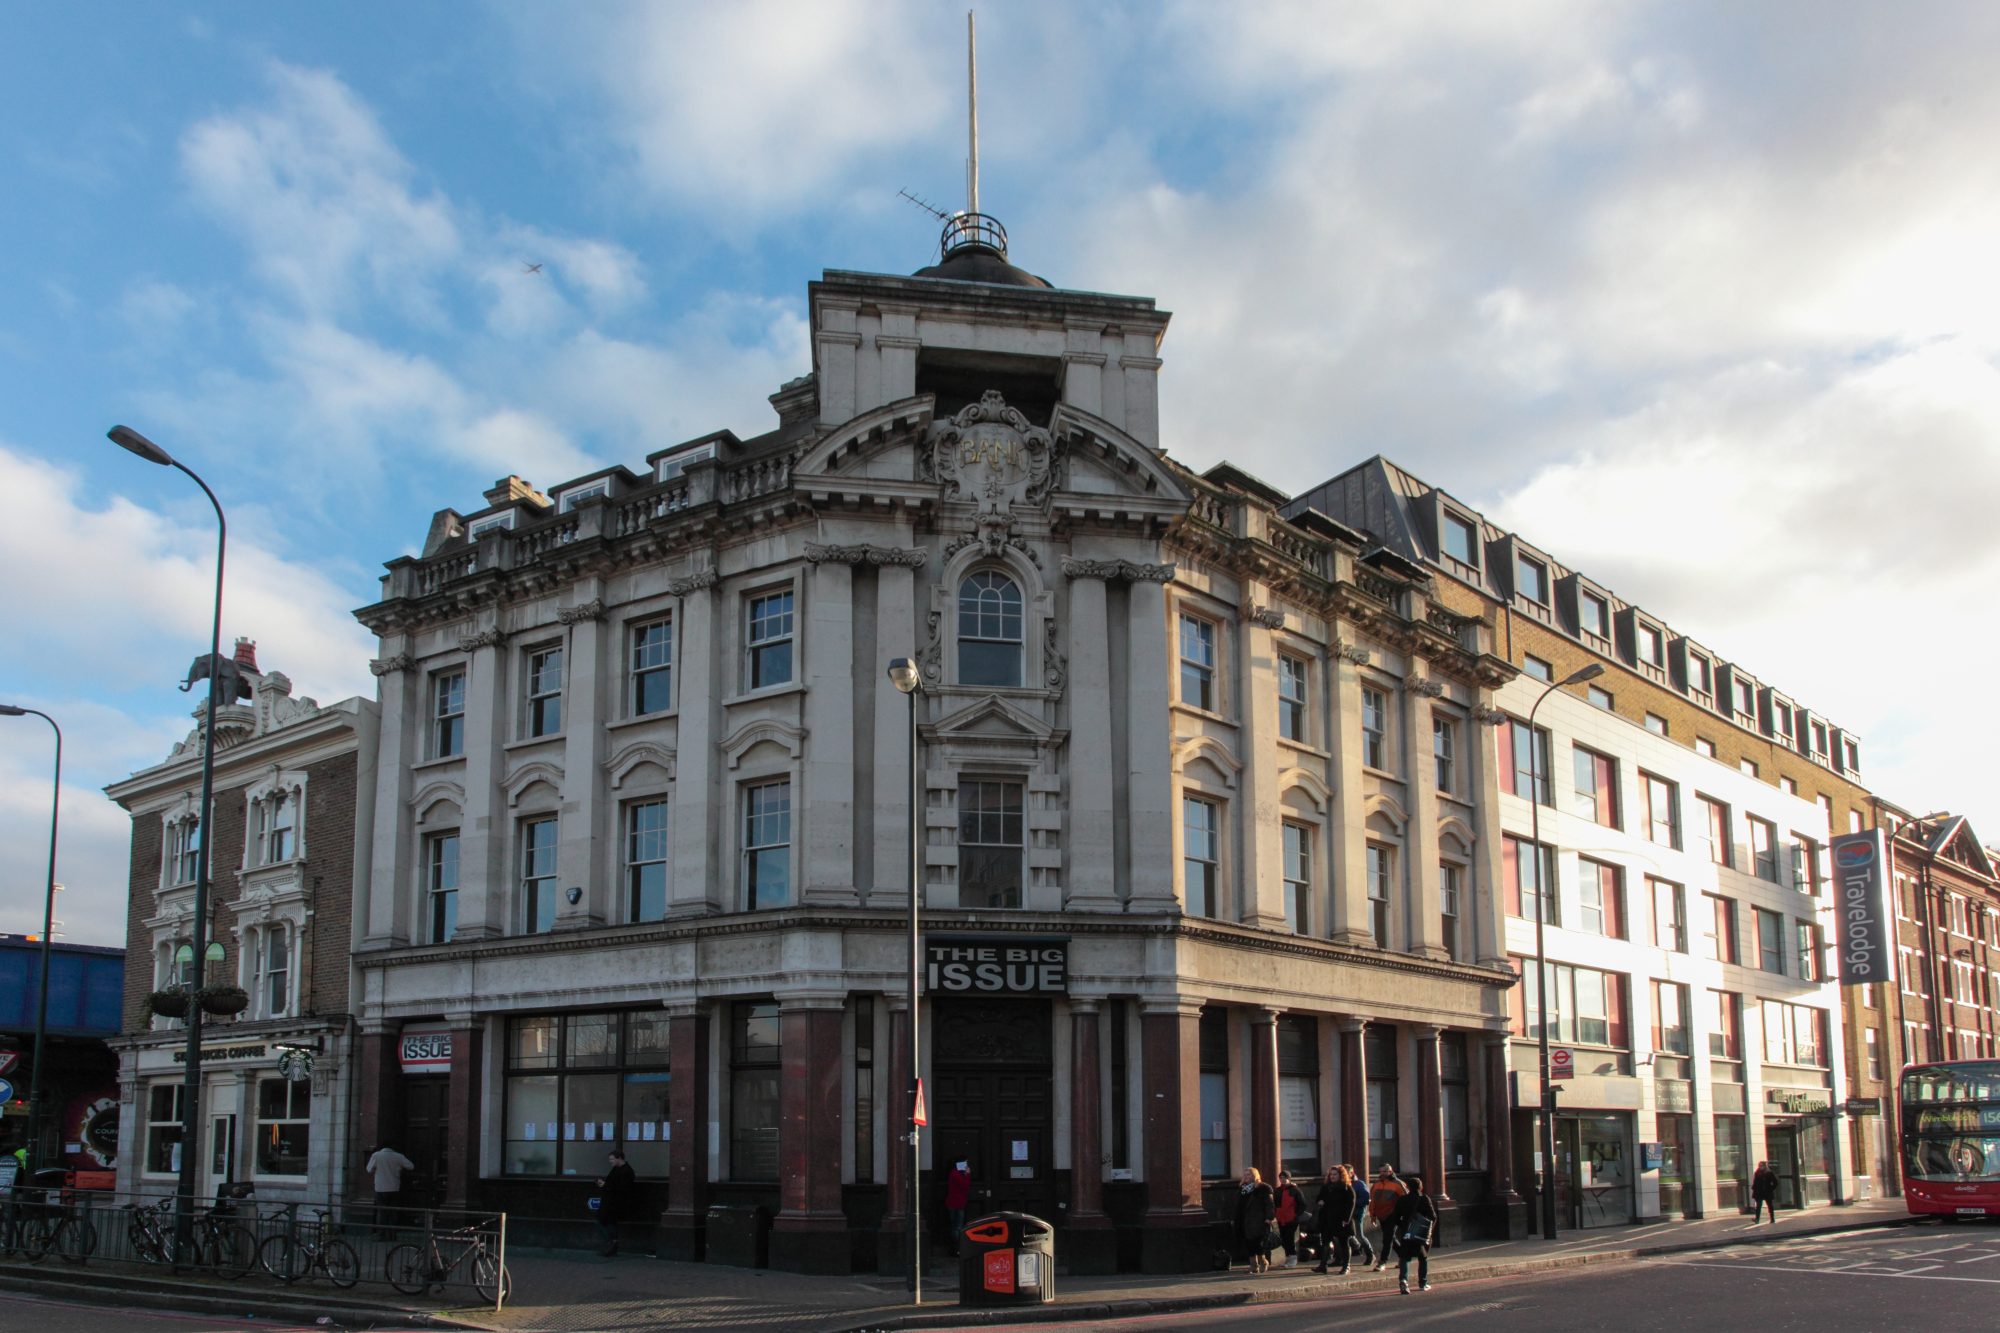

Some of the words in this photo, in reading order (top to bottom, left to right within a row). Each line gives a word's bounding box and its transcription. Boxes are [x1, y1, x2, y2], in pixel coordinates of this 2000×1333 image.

[1845, 868, 1876, 975] Travelodge
[929, 947, 998, 961] THE
[1006, 949, 1064, 962] BIG
[928, 963, 1065, 991] ISSUE
[406, 1035, 430, 1044] THE
[228, 1045, 265, 1058] COFFEE
[403, 1042, 452, 1059] ISSUE
[1787, 1093, 1828, 1112] Waitrose
[1921, 1113, 1975, 1123] Wimbledon
